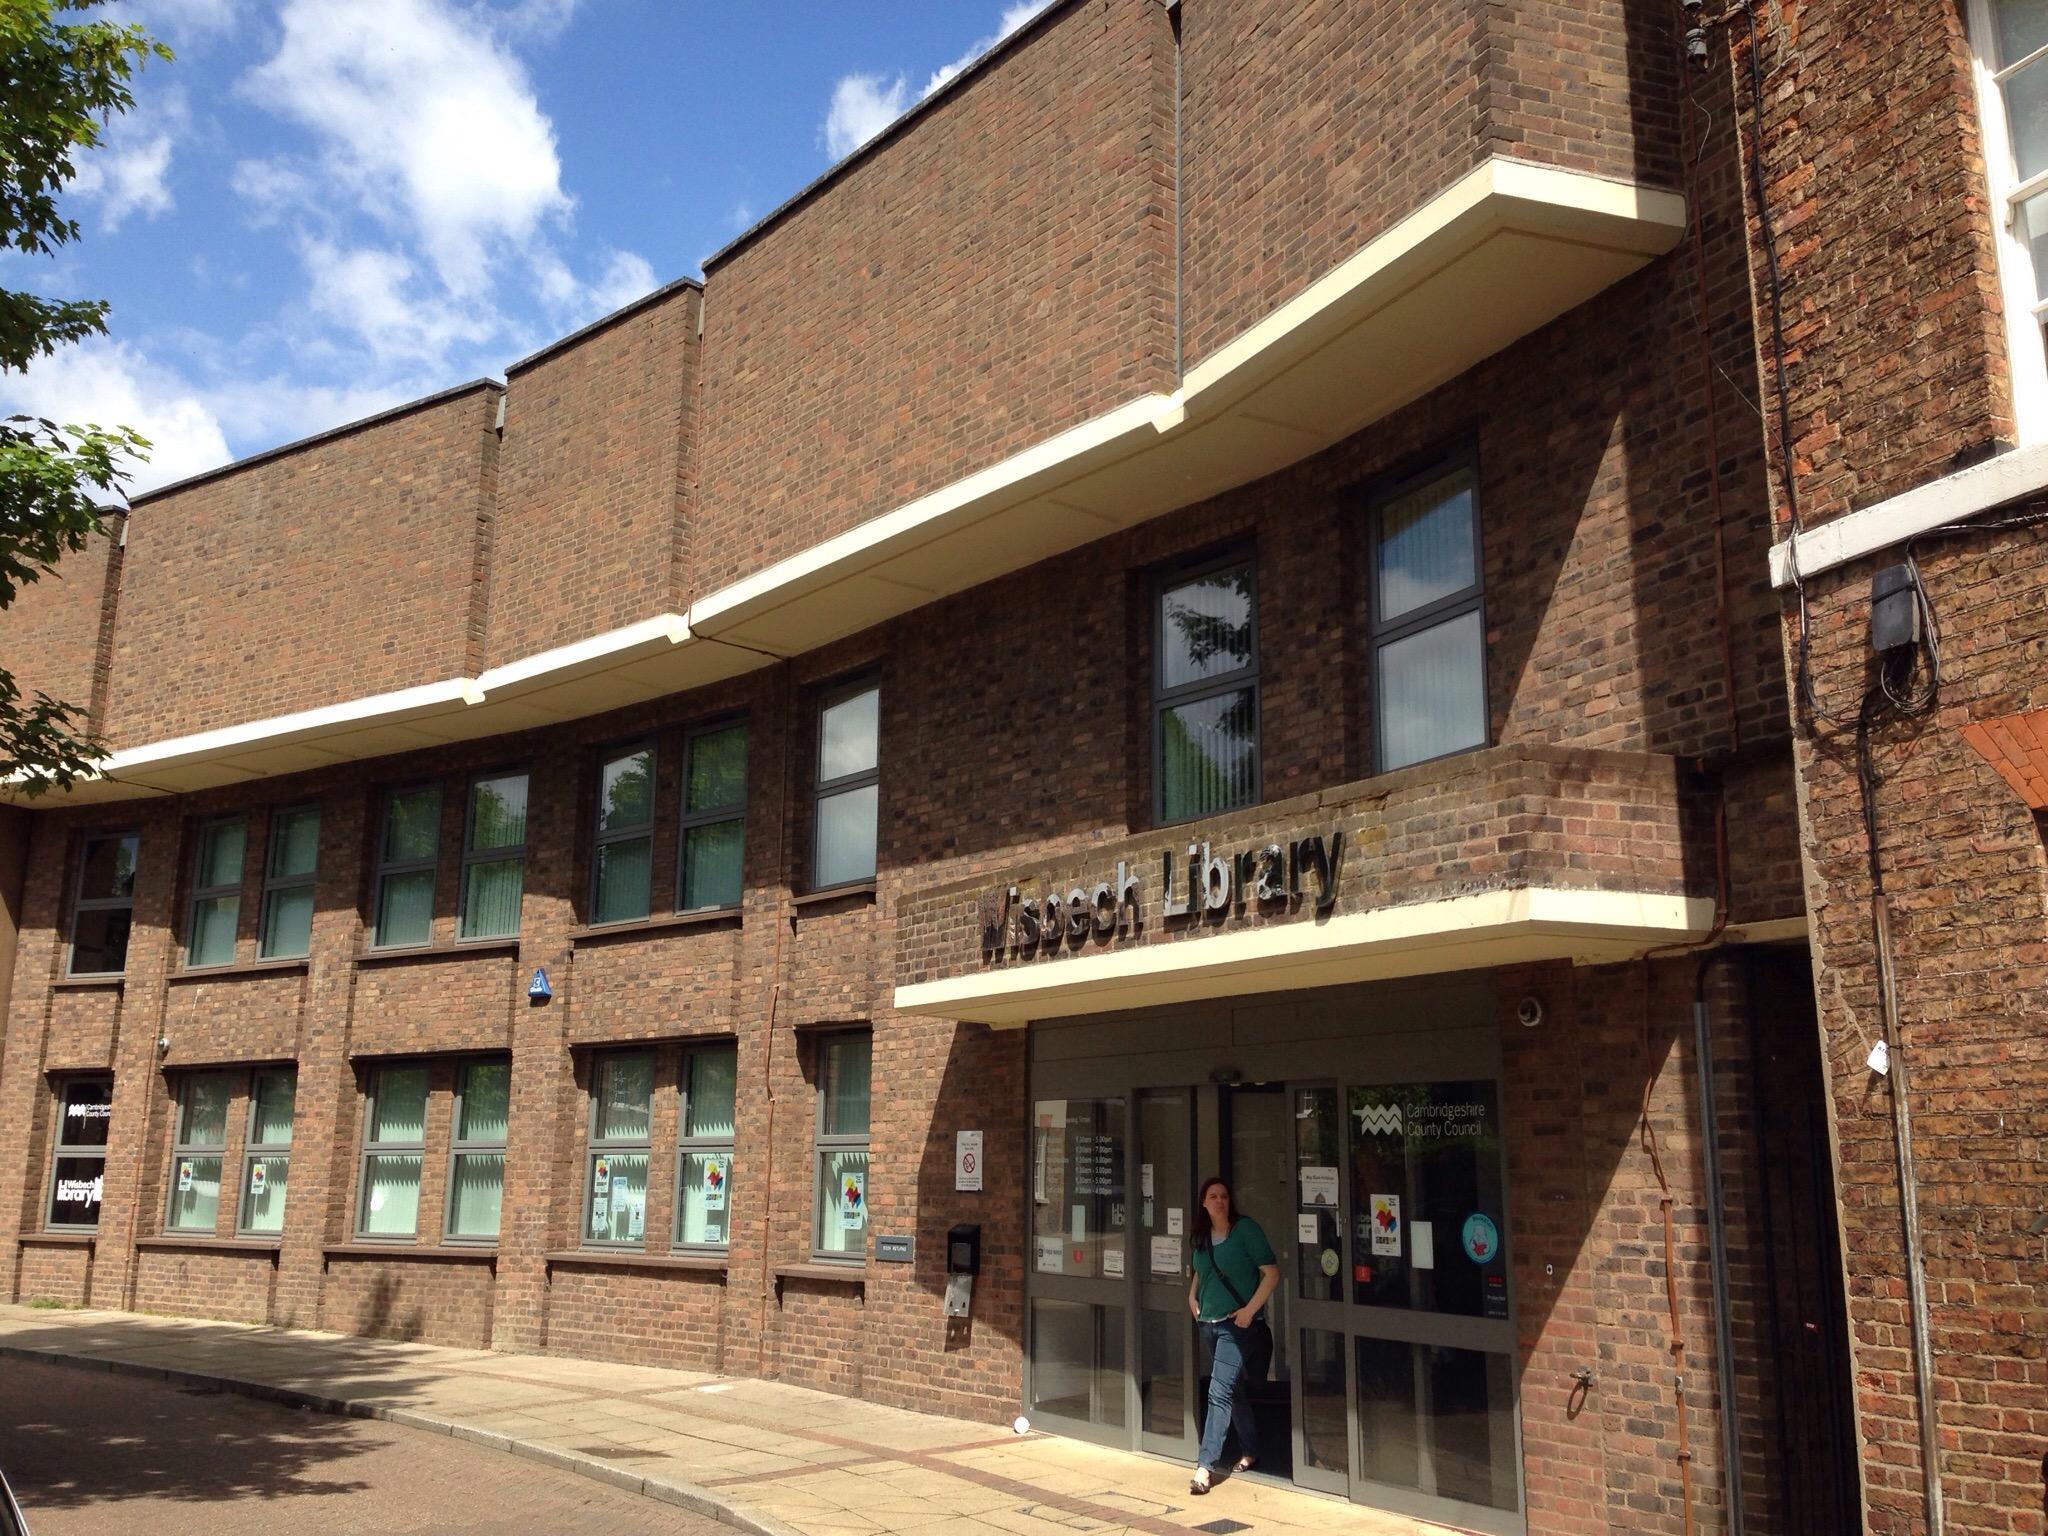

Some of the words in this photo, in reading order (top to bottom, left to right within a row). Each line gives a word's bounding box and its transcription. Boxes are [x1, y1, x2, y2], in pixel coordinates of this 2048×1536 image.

[978, 861, 1142, 952] Wisbech
[1163, 832, 1344, 917] Library
[1406, 1101, 1486, 1121] Cambridgeshire
[1407, 1121, 1442, 1139] County
[1443, 1120, 1482, 1136] Council
[67, 1180, 95, 1189] Wisbech
